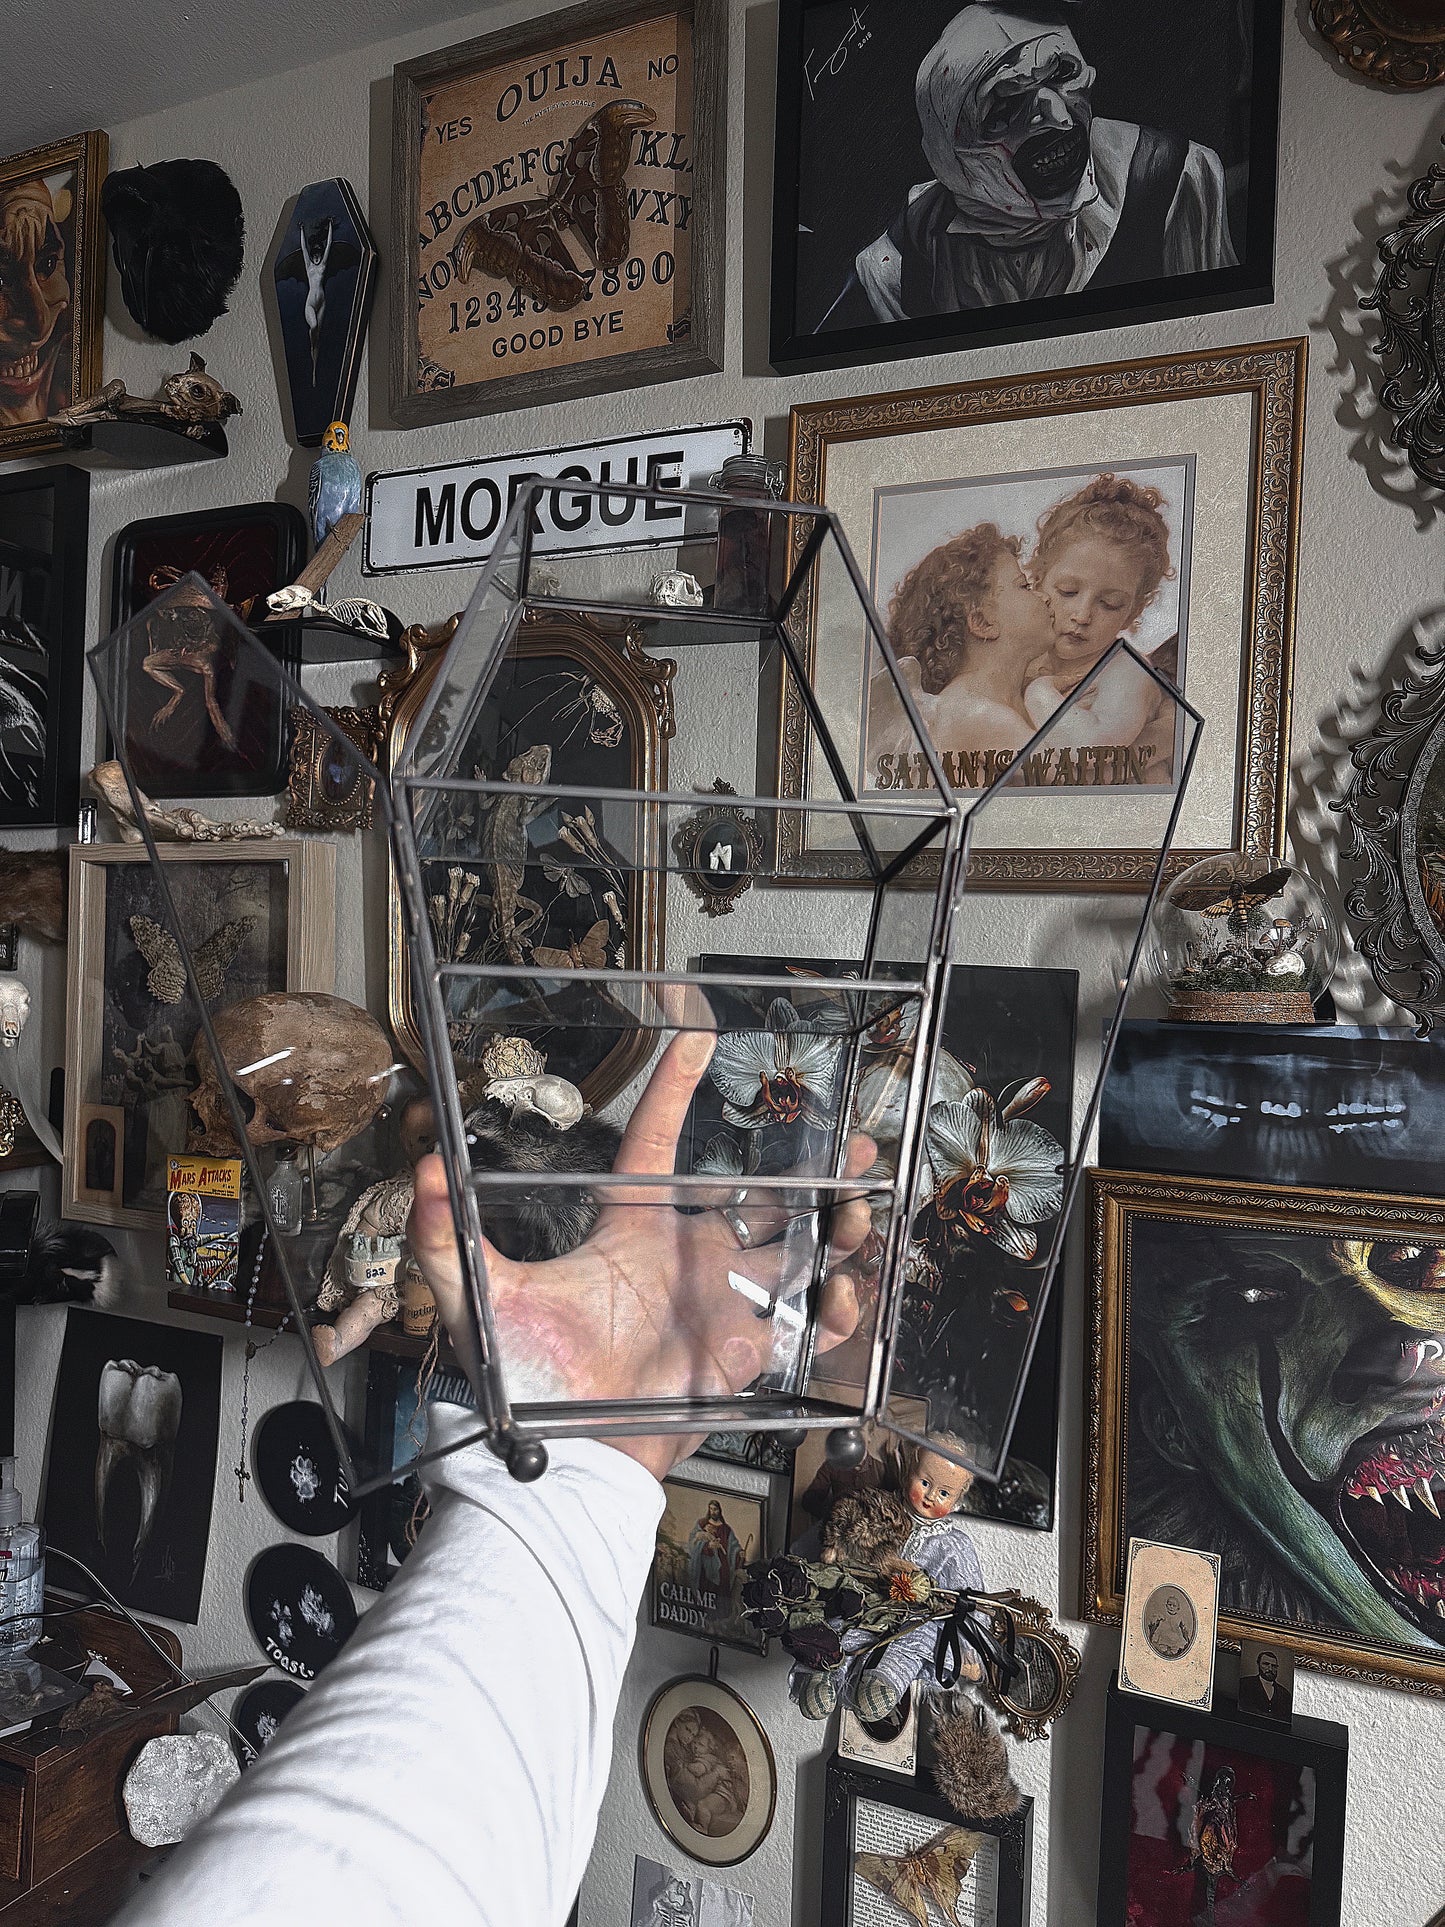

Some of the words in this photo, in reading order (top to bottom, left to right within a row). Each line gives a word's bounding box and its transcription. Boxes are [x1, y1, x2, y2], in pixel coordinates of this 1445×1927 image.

[647, 54, 680, 81] NO
[496, 55, 622, 123] OUIJA
[435, 116, 473, 145] YES
[492, 325, 564, 358] GOOD
[574, 310, 624, 342] BYE
[414, 450, 686, 549] MORGUE
[875, 749, 980, 790] SATAN
[982, 749, 1014, 789] IS
[169, 1168, 196, 1190] MARS
[197, 1166, 232, 1188] ATTACKS
[660, 1581, 695, 1605] CALL
[697, 1590, 717, 1610] ME
[660, 1601, 708, 1628] DADDY
